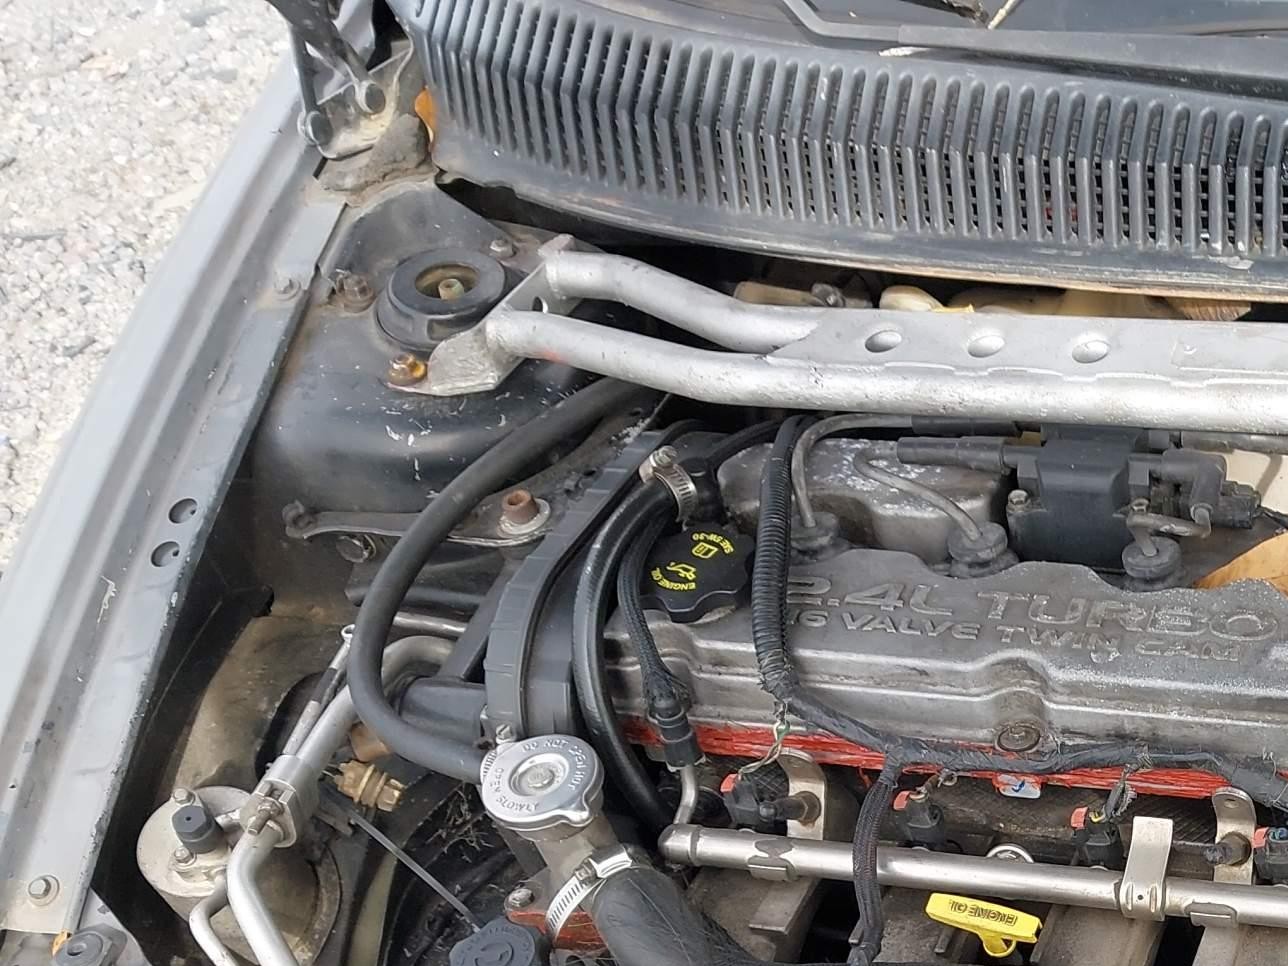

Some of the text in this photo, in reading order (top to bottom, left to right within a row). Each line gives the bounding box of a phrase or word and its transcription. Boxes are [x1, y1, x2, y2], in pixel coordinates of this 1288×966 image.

[657, 578, 697, 591] ENGINE
[785, 574, 1280, 641] 2.4L TURBO
[842, 611, 981, 640] VALVE
[998, 624, 1121, 664] TWIN
[1135, 641, 1241, 662] CAM
[949, 899, 1019, 926] ENGINE OIL
